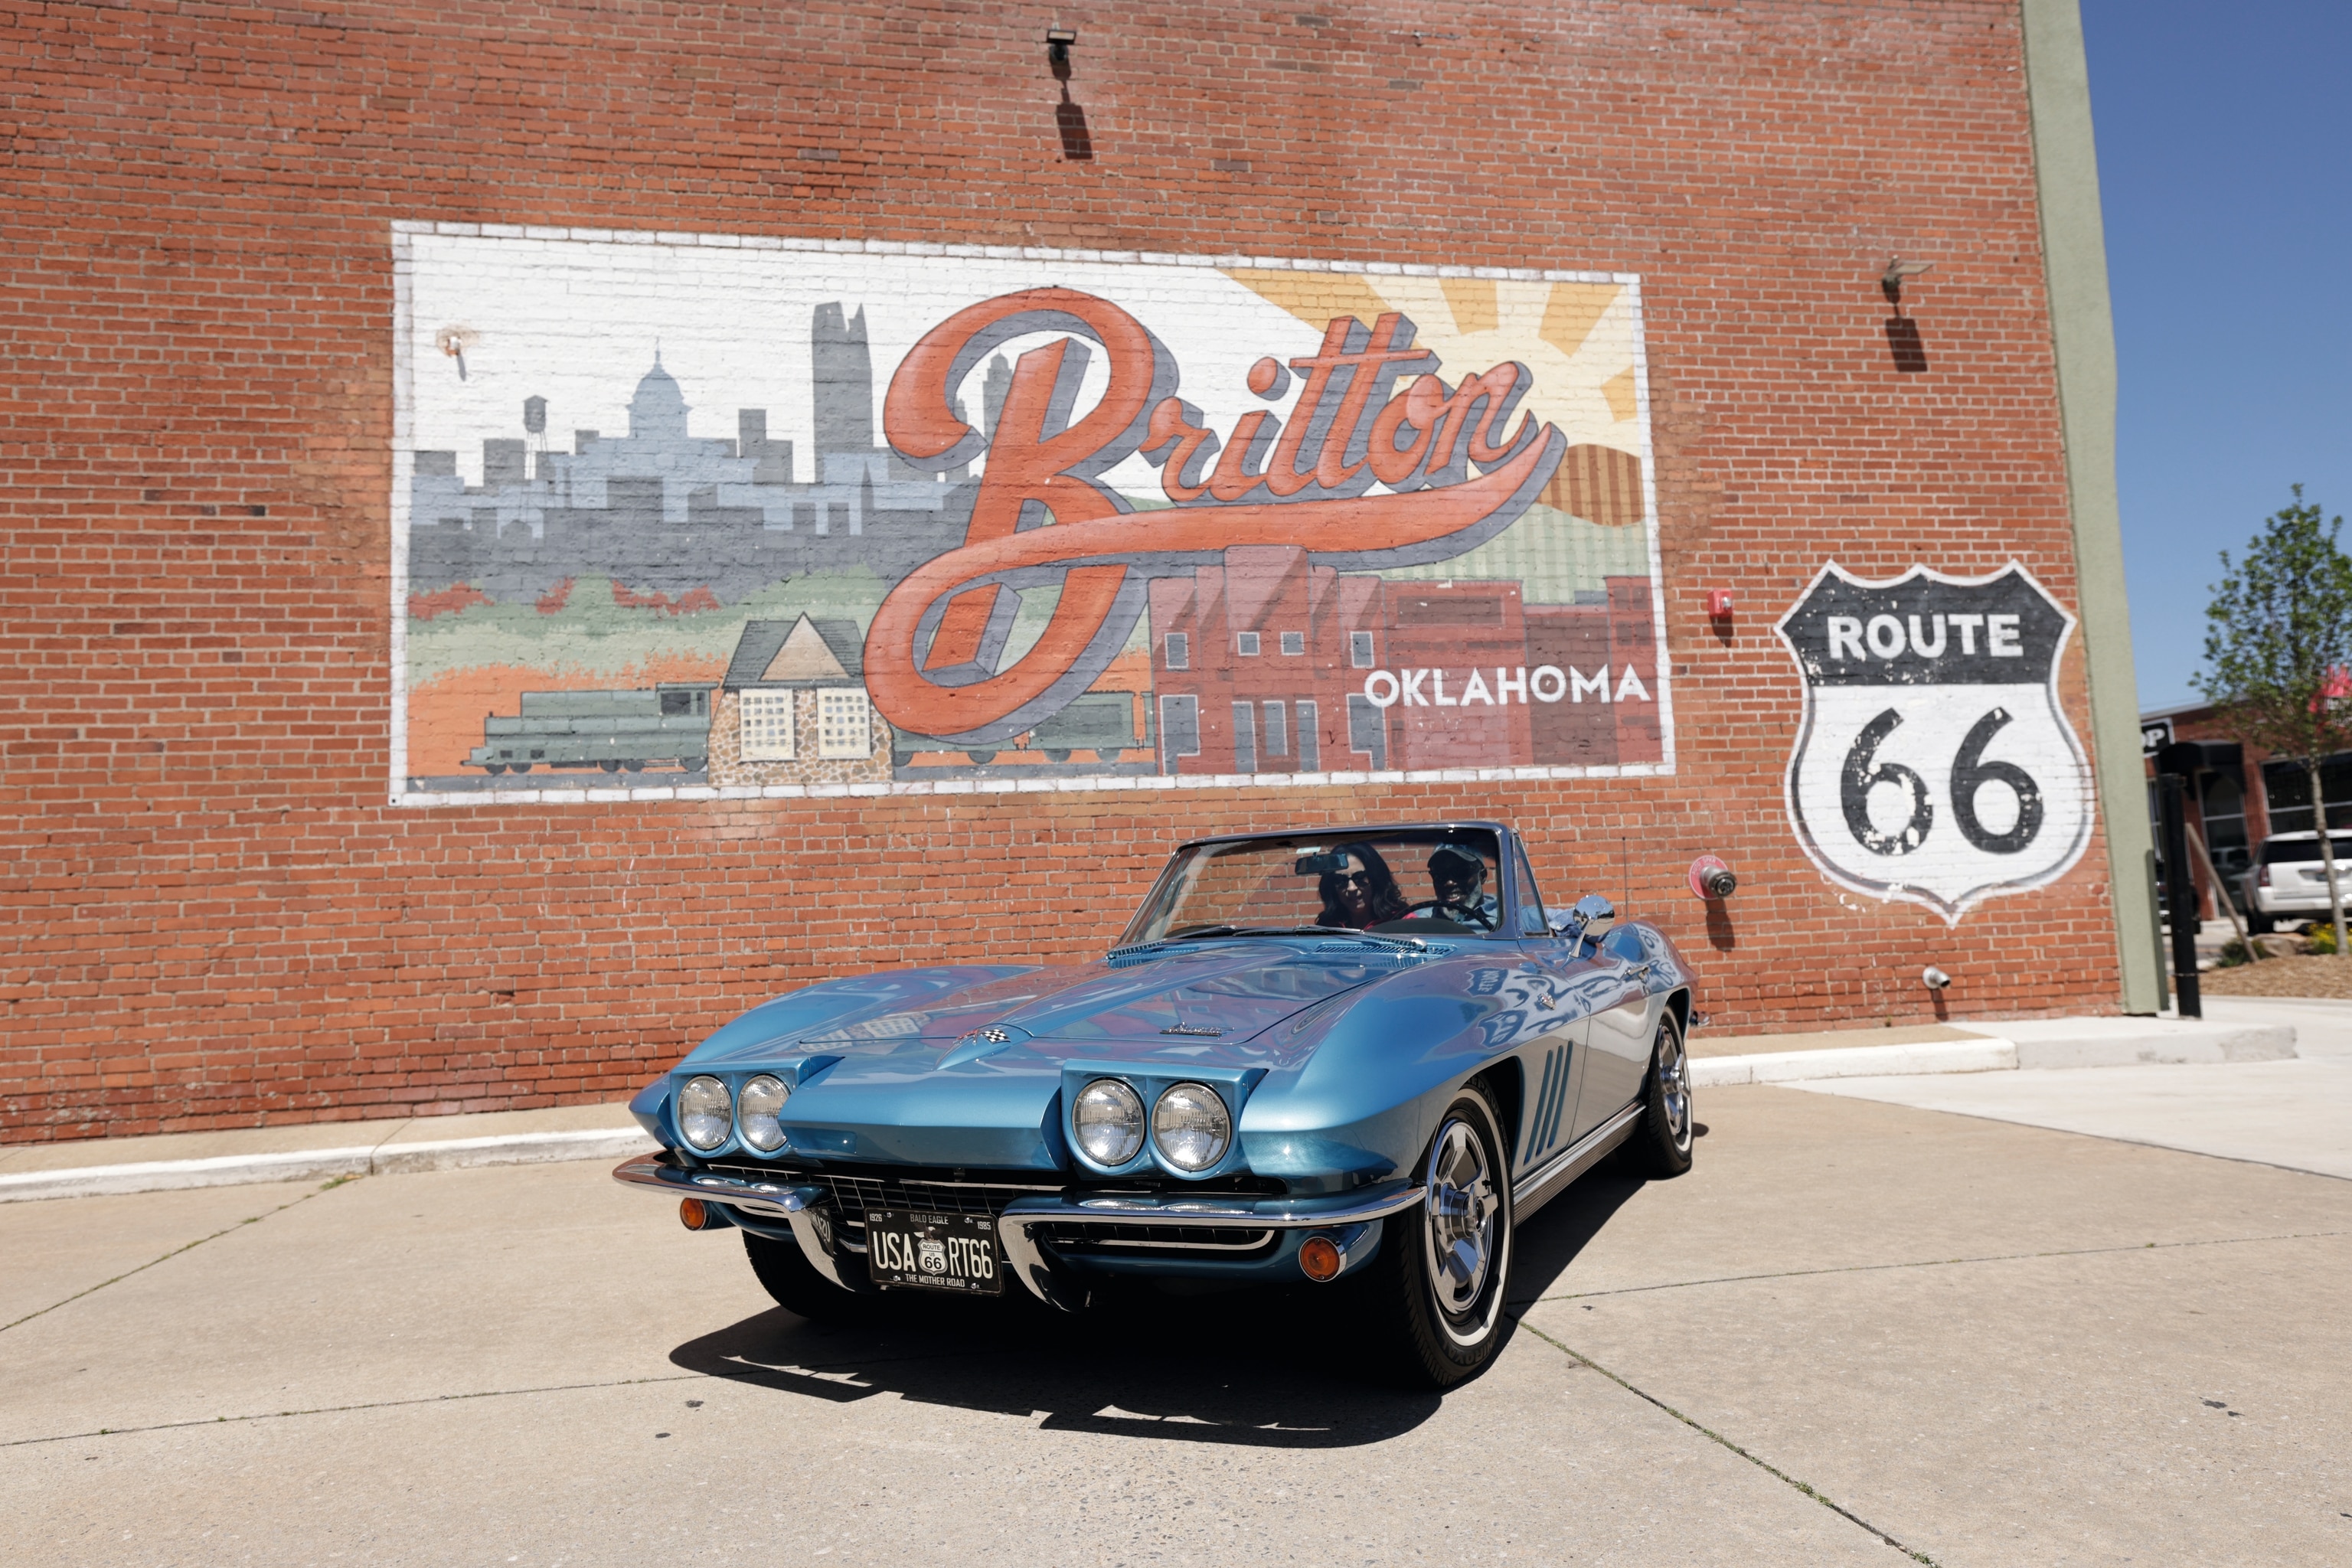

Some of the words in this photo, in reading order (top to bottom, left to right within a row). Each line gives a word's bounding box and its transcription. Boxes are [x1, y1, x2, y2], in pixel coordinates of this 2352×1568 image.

[862, 285, 1568, 746] Britton
[1827, 614, 2024, 660] ROUTE
[1364, 663, 1651, 708] OKLAHOMA
[1841, 706, 2044, 856] 66
[869, 1213, 883, 1222] 1926
[910, 1214, 927, 1223] BALD
[929, 1215, 949, 1225] EAGLE
[977, 1221, 991, 1230] 1985
[873, 1231, 916, 1272] USA
[948, 1236, 994, 1279] RT66
[926, 1257, 942, 1269] 66
[905, 1273, 918, 1283] THE
[919, 1274, 946, 1286] MOTHER
[946, 1277, 965, 1288] ROAD
[1442, 1325, 1499, 1365] UNIROYAL
